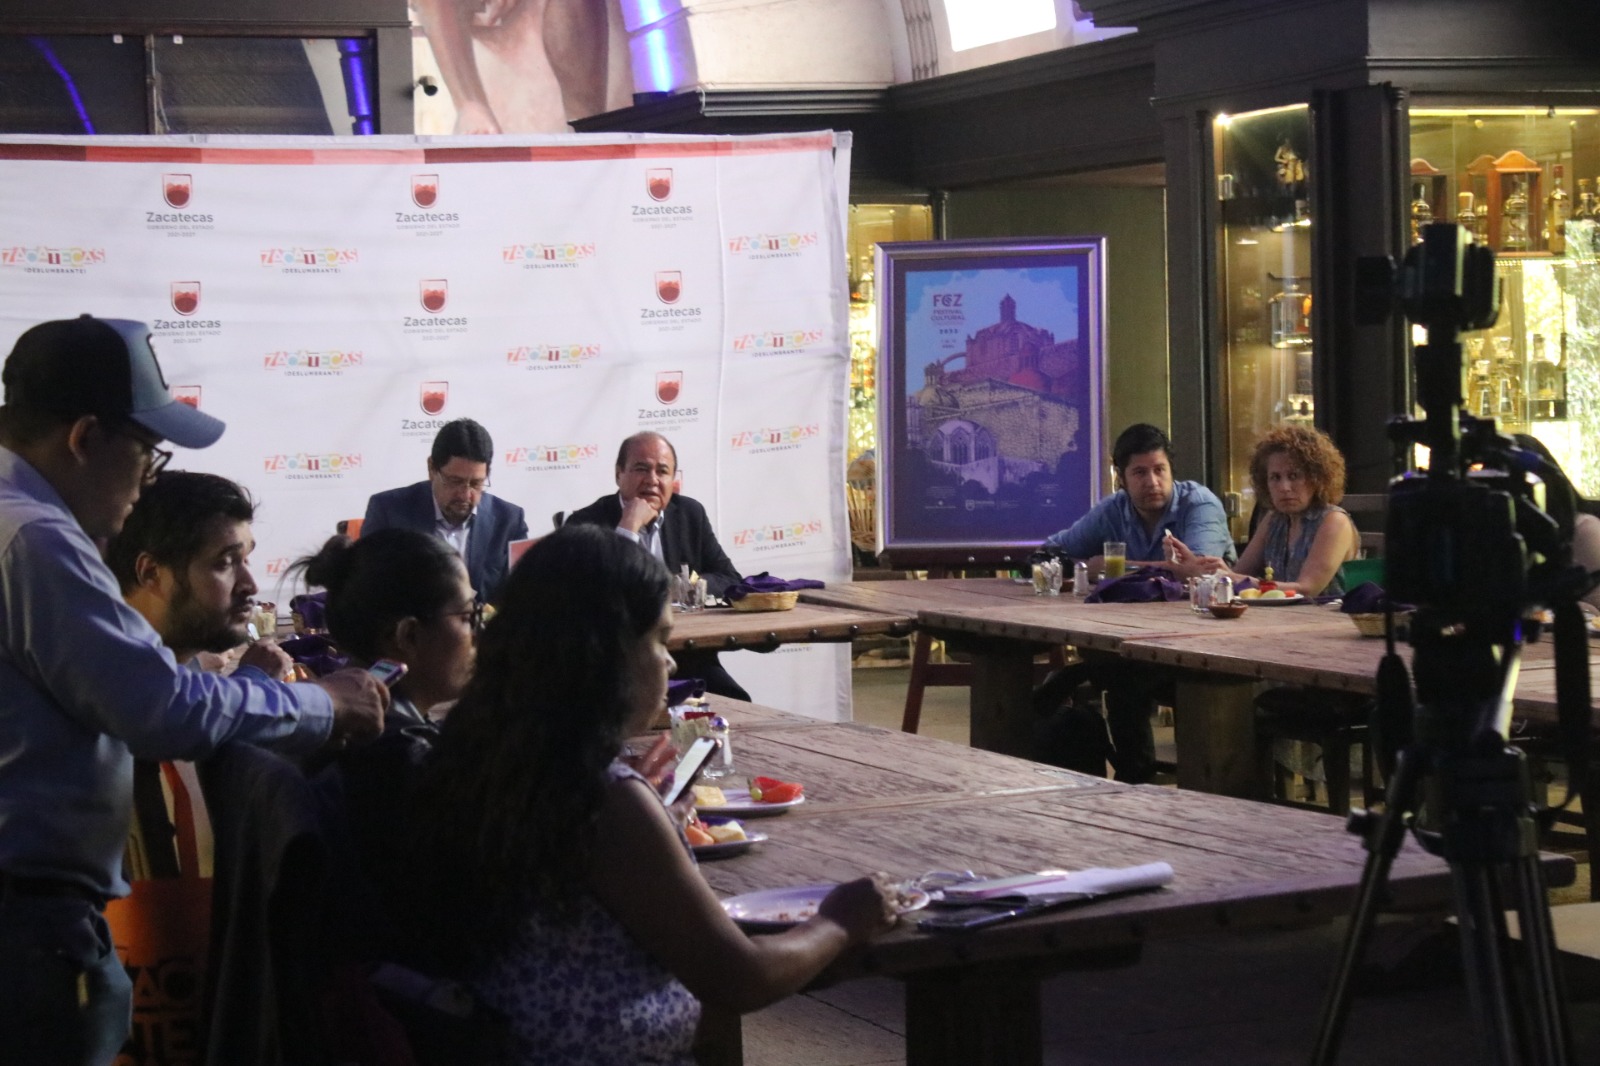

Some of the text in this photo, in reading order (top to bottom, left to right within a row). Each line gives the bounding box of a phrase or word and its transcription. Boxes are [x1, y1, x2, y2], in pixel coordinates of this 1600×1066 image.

[146, 212, 214, 222] Zacatecas
[395, 212, 460, 222] Zacatecas
[631, 205, 693, 215] Zacatecas
[502, 242, 596, 264] ZACATECAS
[729, 232, 818, 255] ZACATECAS
[2, 246, 106, 267] ZACATECAS
[260, 246, 359, 267] ZACATECAS
[403, 317, 467, 326] Zacatecas
[640, 307, 702, 318] Zacatecas
[154, 319, 221, 329] Zacatecas
[734, 329, 823, 353] ZACATECAS
[264, 349, 363, 370] ZACATECAS
[506, 344, 601, 365] ZACATECAS
[638, 407, 699, 419] Zacatecas
[402, 419, 449, 430] Zacate
[731, 423, 820, 450] ZACATECAS
[264, 453, 362, 474] ZACATECAS
[505, 444, 599, 466] ZACATECAS
[734, 519, 822, 548] ZACATECAS
